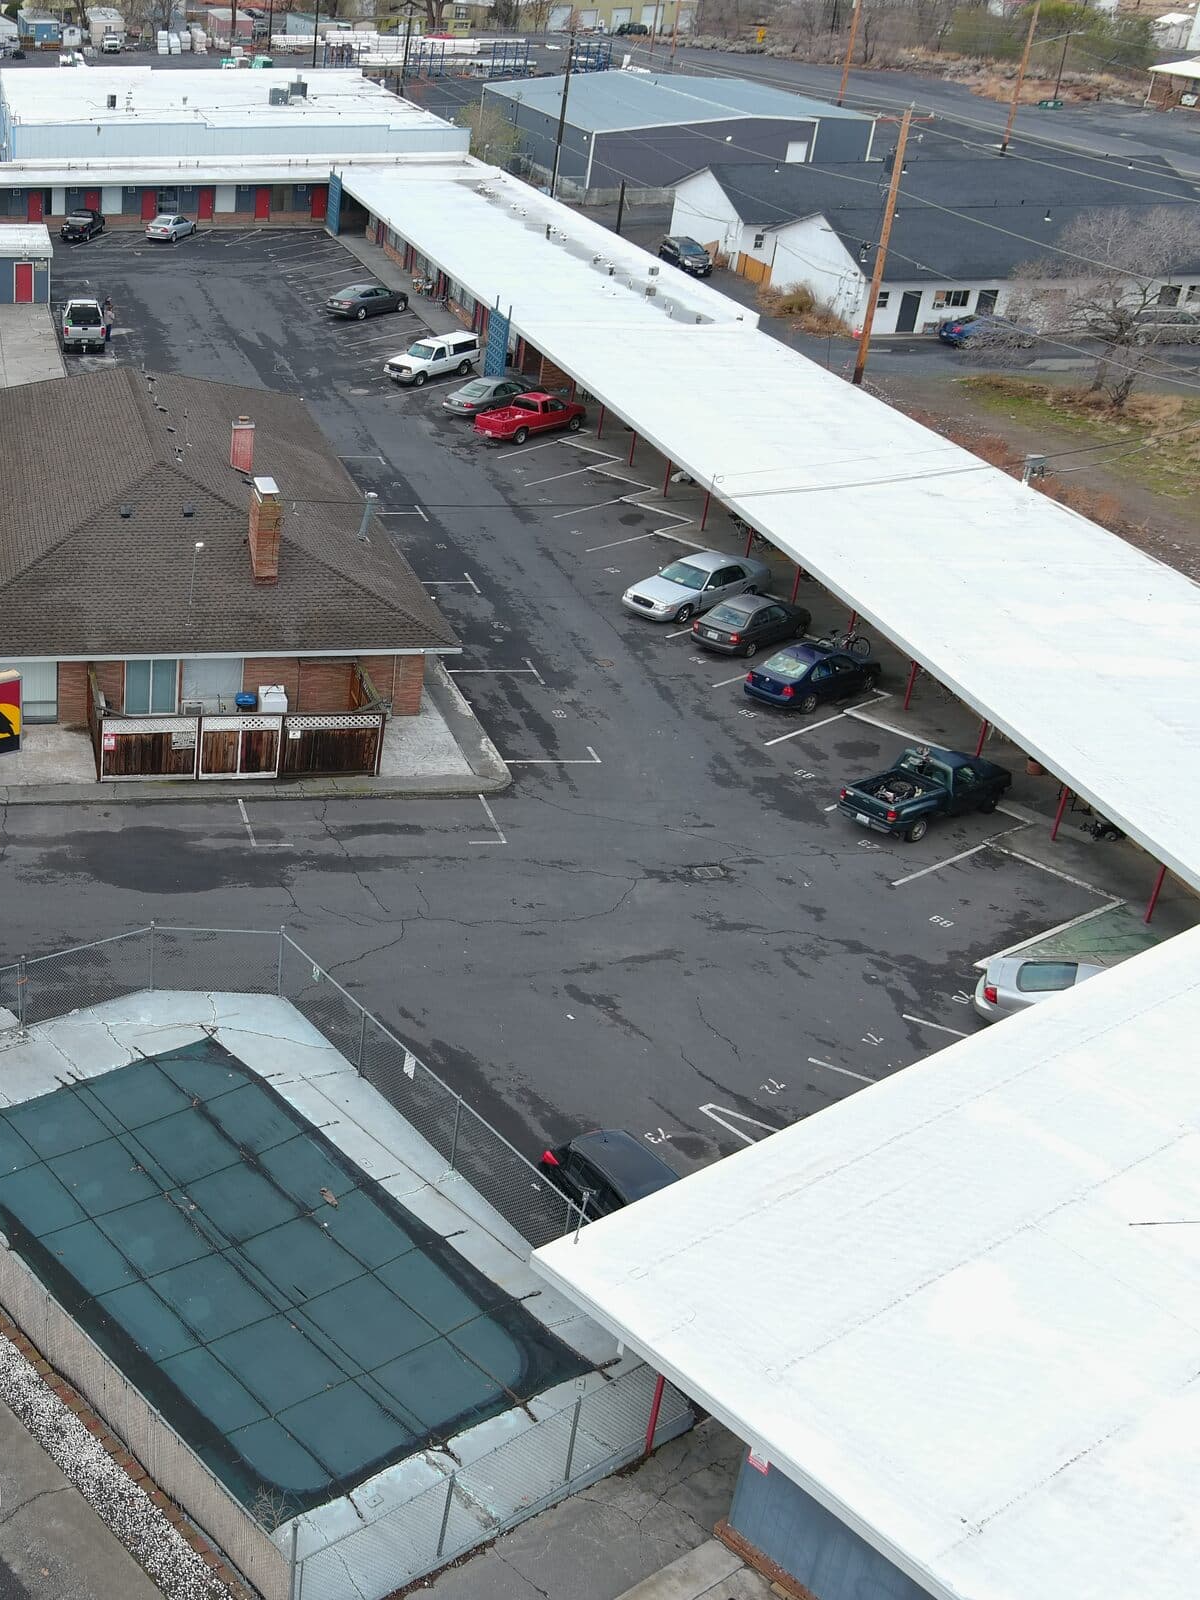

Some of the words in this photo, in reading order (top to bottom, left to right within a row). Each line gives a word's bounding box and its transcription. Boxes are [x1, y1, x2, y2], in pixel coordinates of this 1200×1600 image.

[738, 708, 758, 719] 65
[794, 769, 815, 780] 66
[857, 839, 881, 849] 67
[929, 915, 954, 927] 68
